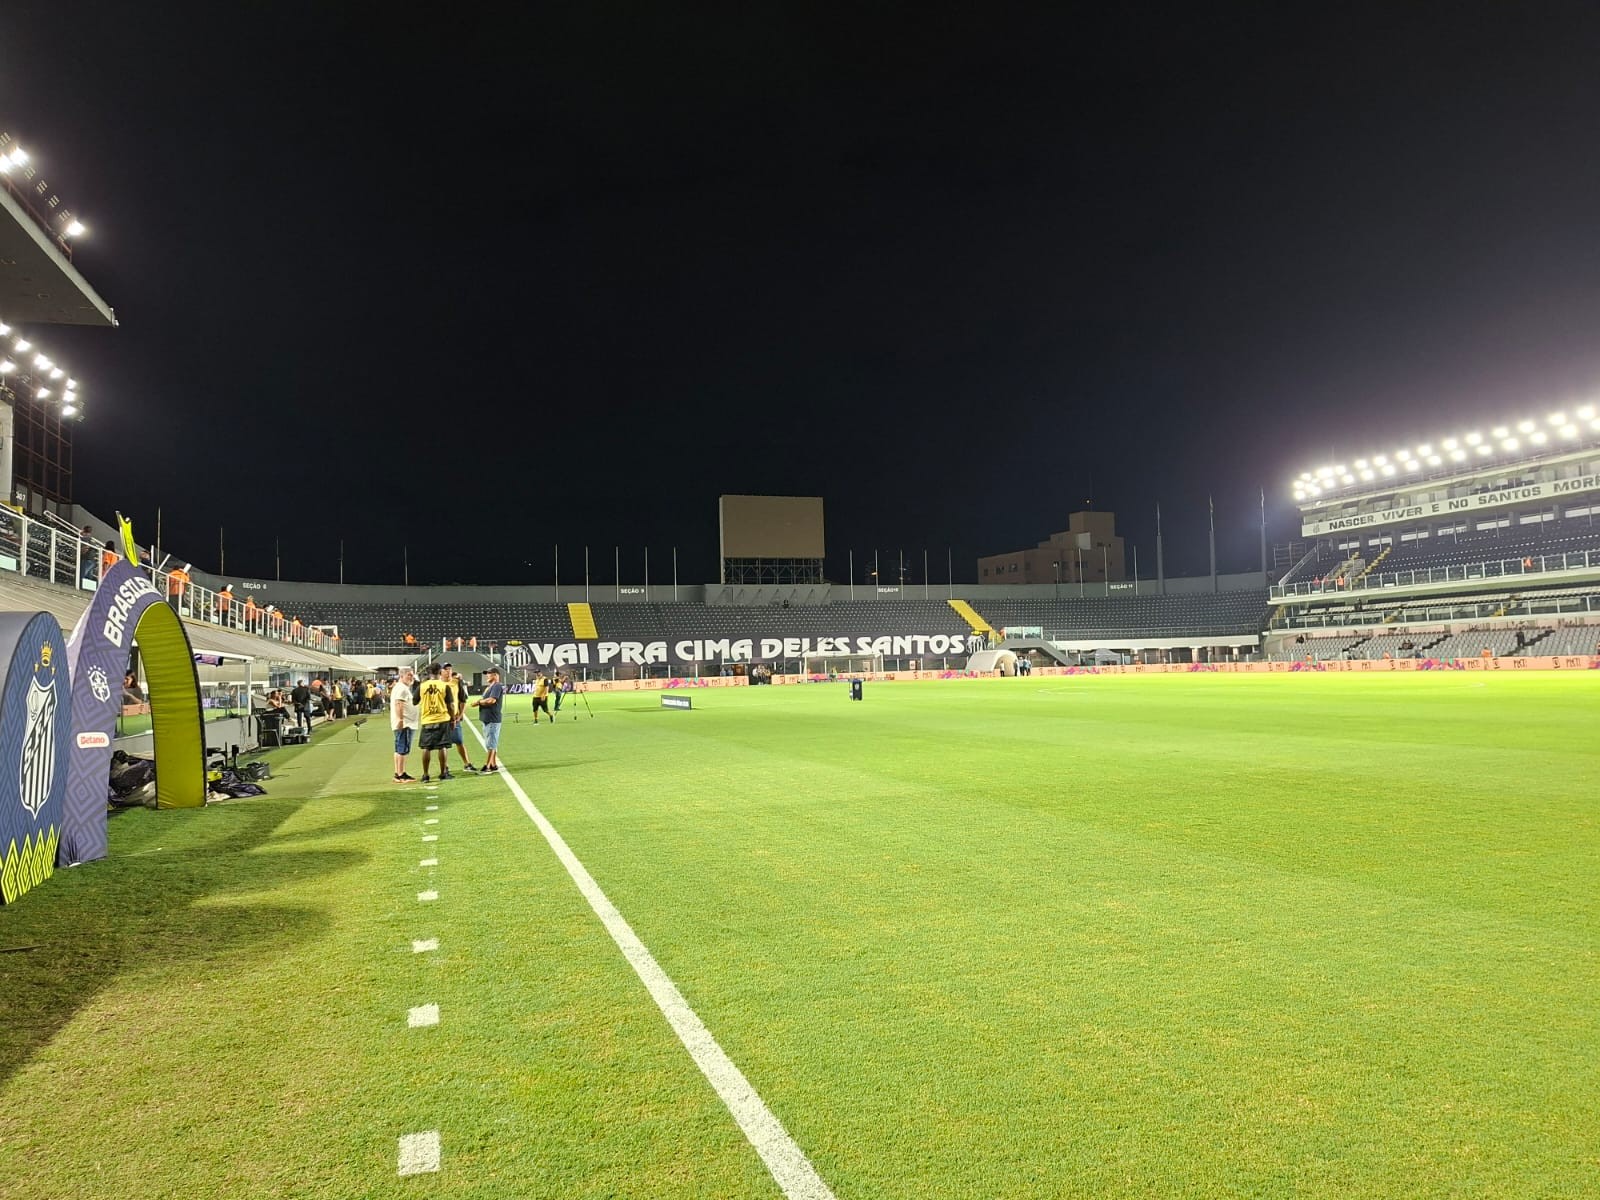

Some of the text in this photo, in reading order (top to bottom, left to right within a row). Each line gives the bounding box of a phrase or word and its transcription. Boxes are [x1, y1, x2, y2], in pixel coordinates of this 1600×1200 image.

[1381, 506, 1423, 521] VIVER
[1431, 503, 1440, 513] E
[1448, 498, 1469, 510] NO
[1478, 486, 1541, 505] SANTOS
[528, 634, 965, 668] VAI PRA CIMA DELES SANTOS
